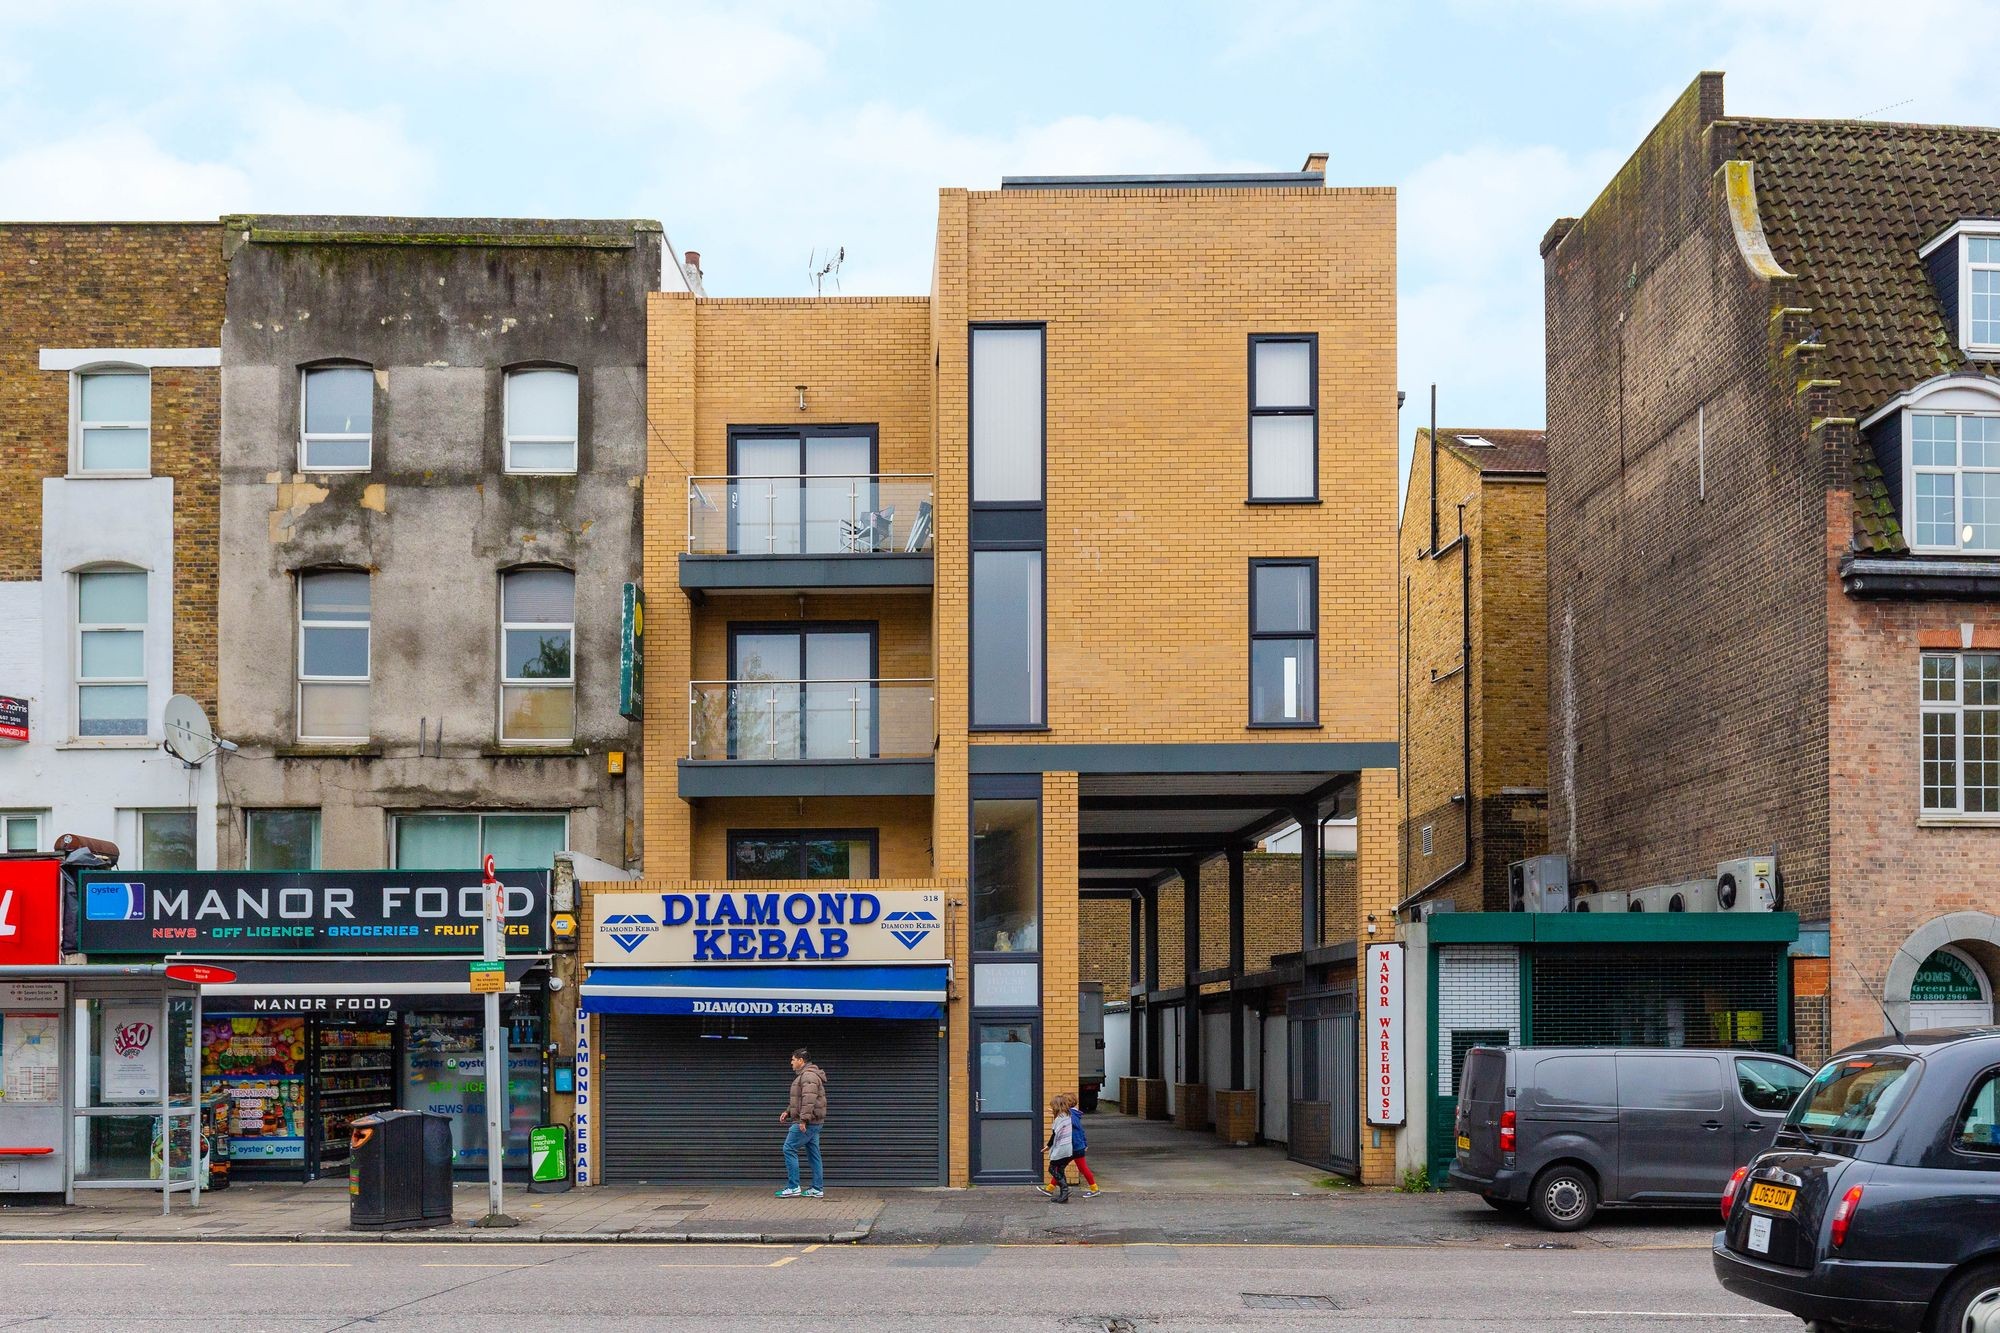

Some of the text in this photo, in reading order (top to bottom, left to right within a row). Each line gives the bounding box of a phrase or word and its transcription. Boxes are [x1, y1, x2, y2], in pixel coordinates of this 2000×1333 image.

[90, 886, 120, 896] oyster
[153, 887, 534, 920] MANOR FOOD
[662, 893, 881, 926] DIAMOND
[152, 927, 197, 938] NEWS
[212, 927, 243, 938] OFF
[246, 926, 314, 937] LICENCE
[328, 926, 420, 936] GROCERIES
[434, 925, 479, 936] FRUIT
[693, 928, 850, 960] KEBAB
[1914, 972, 1952, 982] OOMS
[254, 998, 392, 1010] MANOR FOOD
[692, 1001, 834, 1014] DIAMOND KEBAB
[1380, 951, 1391, 1120] MANOR WAREHOUSE
[459, 1060, 485, 1068] oyste
[576, 1010, 588, 1182] DIAMOND KEBAB
[240, 1110, 264, 1118] WINES
[429, 1104, 463, 1114] NEWS
[240, 1120, 264, 1128] SPIRITS
[238, 1144, 301, 1153] oyster oyster
